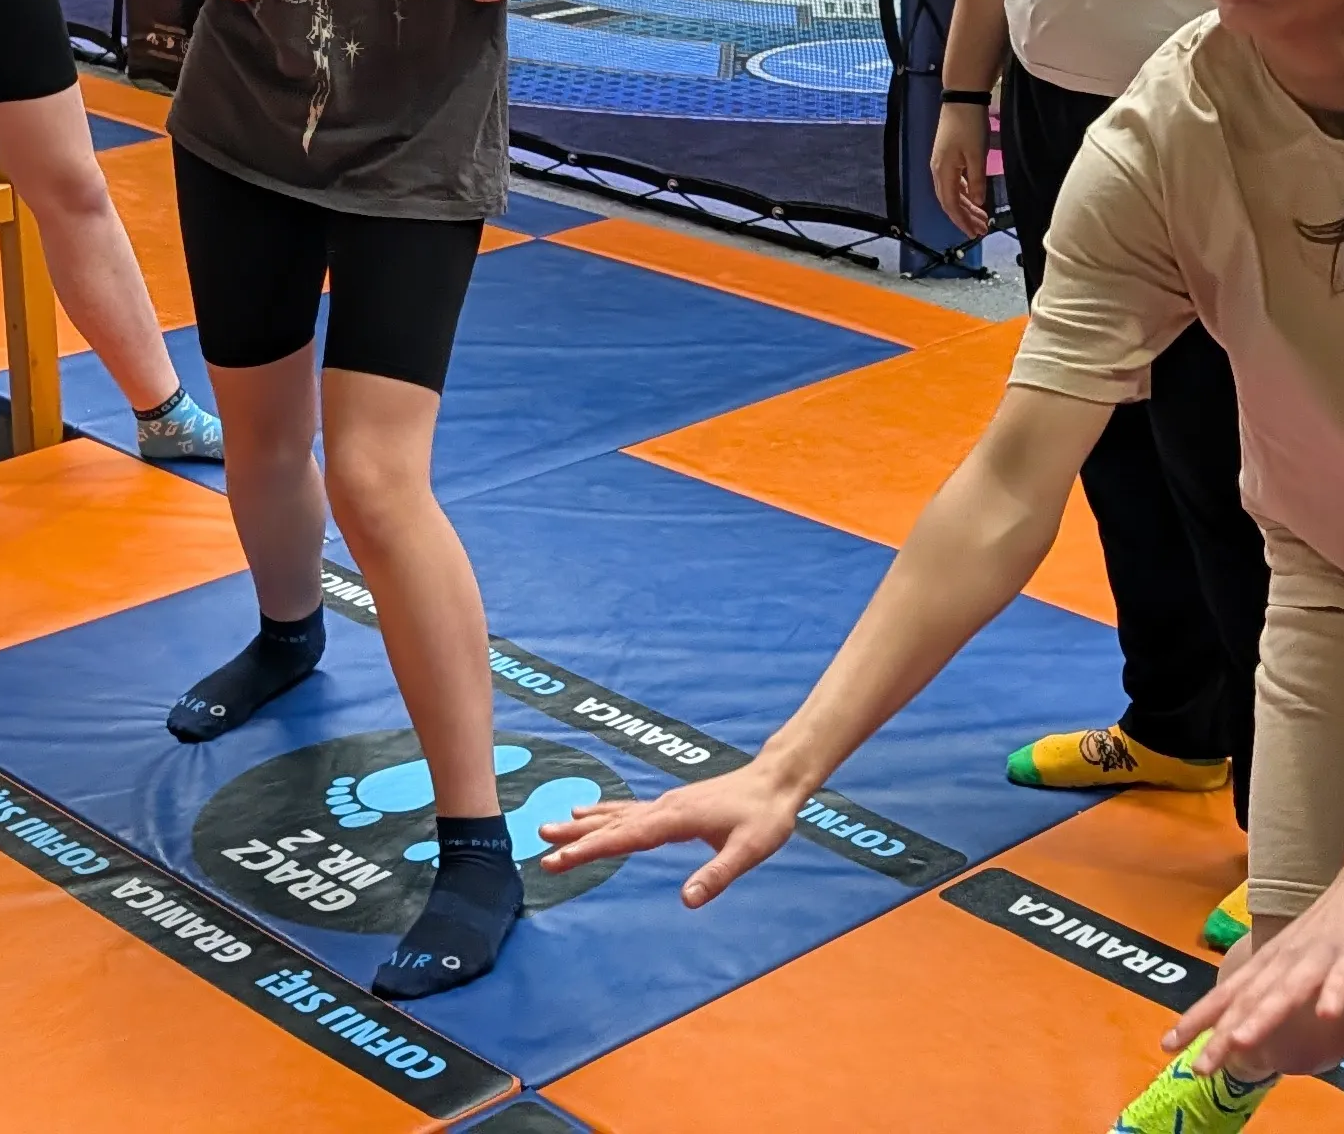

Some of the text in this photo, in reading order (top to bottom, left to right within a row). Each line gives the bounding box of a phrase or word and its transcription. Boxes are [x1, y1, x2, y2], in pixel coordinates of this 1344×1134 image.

[489, 647, 712, 766] GRANICA COFN
[5, 816, 110, 876] COFNIJ
[276, 828, 393, 891] NR. 2
[796, 797, 907, 857] COFNI
[220, 838, 357, 912] GRACZ
[110, 877, 253, 964] GRANICA
[1007, 894, 1188, 985] GRANICA
[255, 968, 337, 1014] SIĘ!
[316, 1006, 447, 1080] COFNIJ
